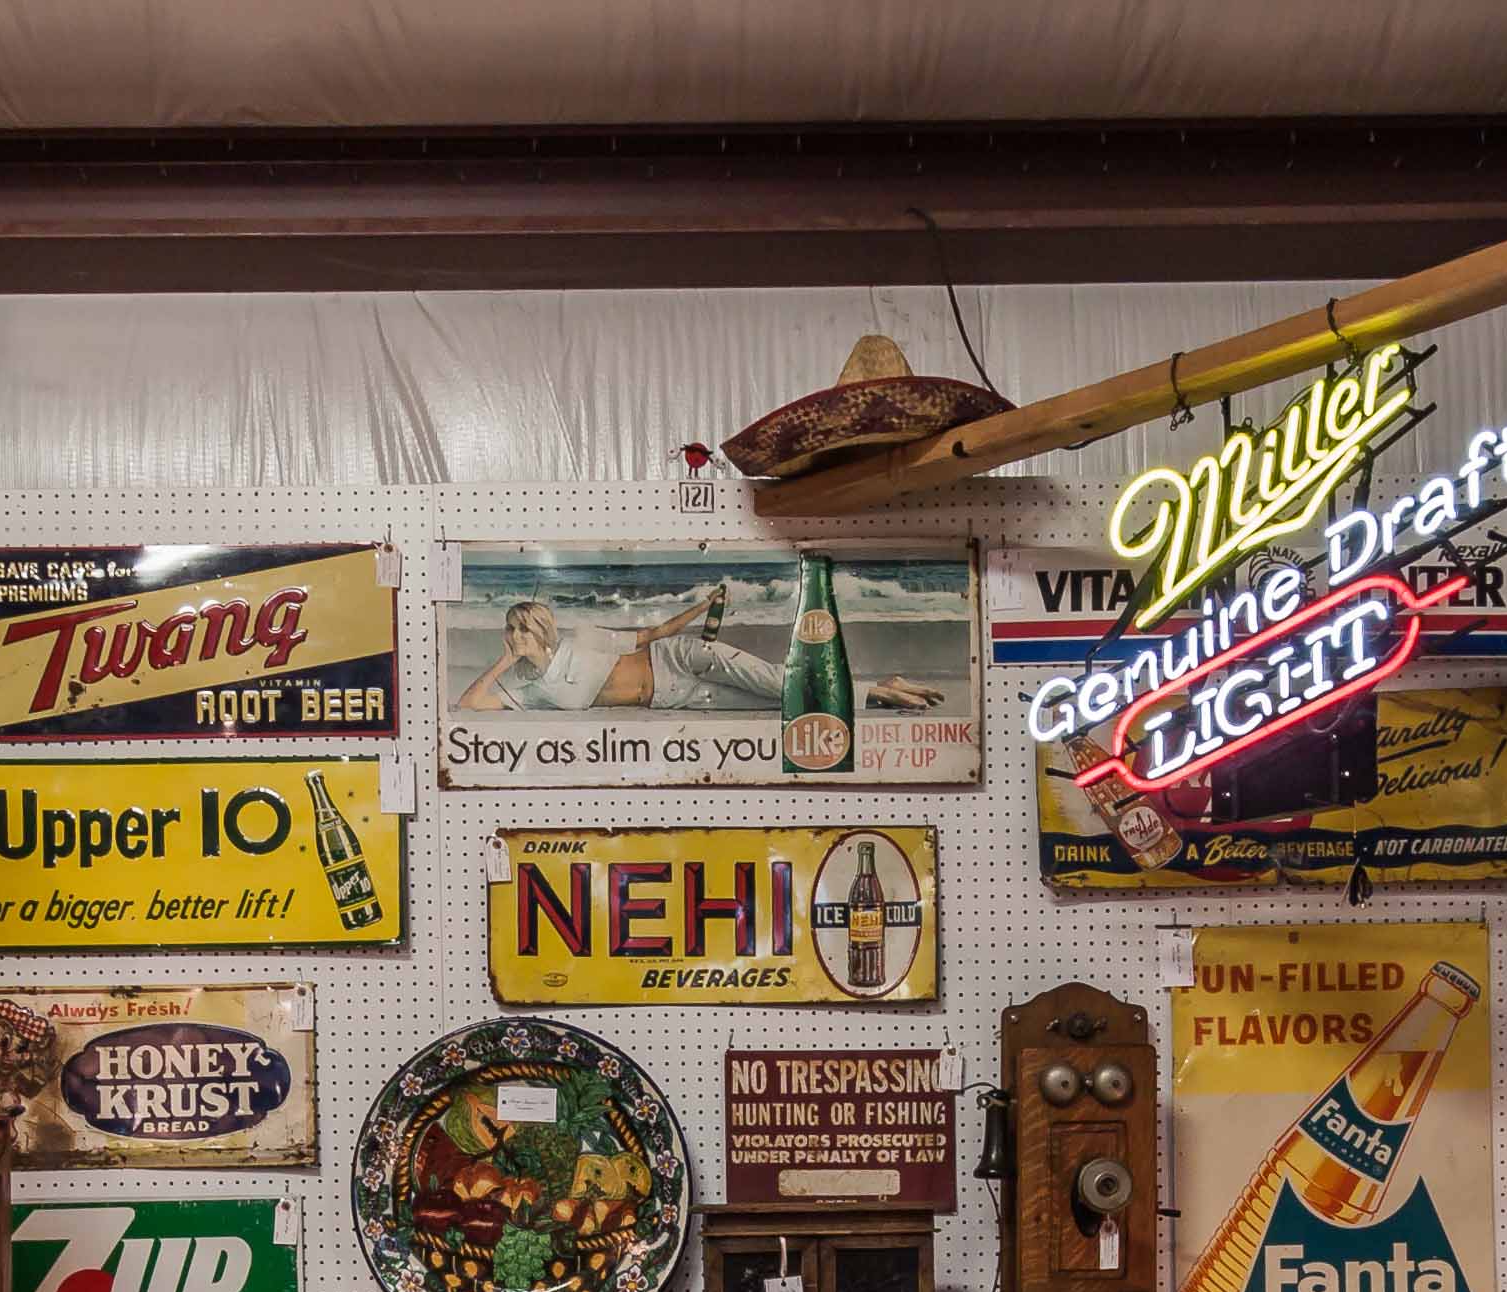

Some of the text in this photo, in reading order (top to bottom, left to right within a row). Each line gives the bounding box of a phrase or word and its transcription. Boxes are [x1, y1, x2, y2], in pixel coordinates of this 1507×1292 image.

[1109, 342, 1403, 600] Miller
[800, 615, 835, 636] Like
[1, 586, 309, 715] Twang
[1028, 568, 1307, 742] Genuine
[258, 678, 324, 689] VITAMIN
[1145, 600, 1387, 779] LIGHT
[195, 687, 385, 725] ROOT BEER
[447, 720, 845, 773] Stay as slim as you Like
[861, 722, 973, 745] DIET DRINK
[861, 749, 886, 773] BY
[201, 786, 293, 857] 10
[523, 841, 587, 854] DRINK
[1055, 844, 1112, 863] DRINK
[1186, 843, 1199, 860] A
[1204, 836, 1269, 866] Better
[1374, 840, 1408, 858] NOT
[19, 898, 37, 920] a
[146, 889, 230, 922] better
[235, 888, 296, 920] lift!
[517, 862, 793, 957] NEHI
[817, 905, 917, 924] ICE COLD
[641, 967, 792, 989] BEVERAGES
[1180, 961, 1406, 994] UN-FILLED
[48, 997, 192, 1021] Always Fresh!
[1193, 1012, 1375, 1046] FLAVORS
[732, 1060, 768, 1095] NO
[95, 1082, 260, 1119] KRUST
[732, 1101, 946, 1126] HUNTING OR FISHING
[143, 1120, 211, 1134] BREAD
[731, 1133, 946, 1148] VIOLATORS PROSECUTED
[1309, 1098, 1393, 1166] Fanta
[731, 1149, 945, 1164] UNDER PENALTY OF LAW
